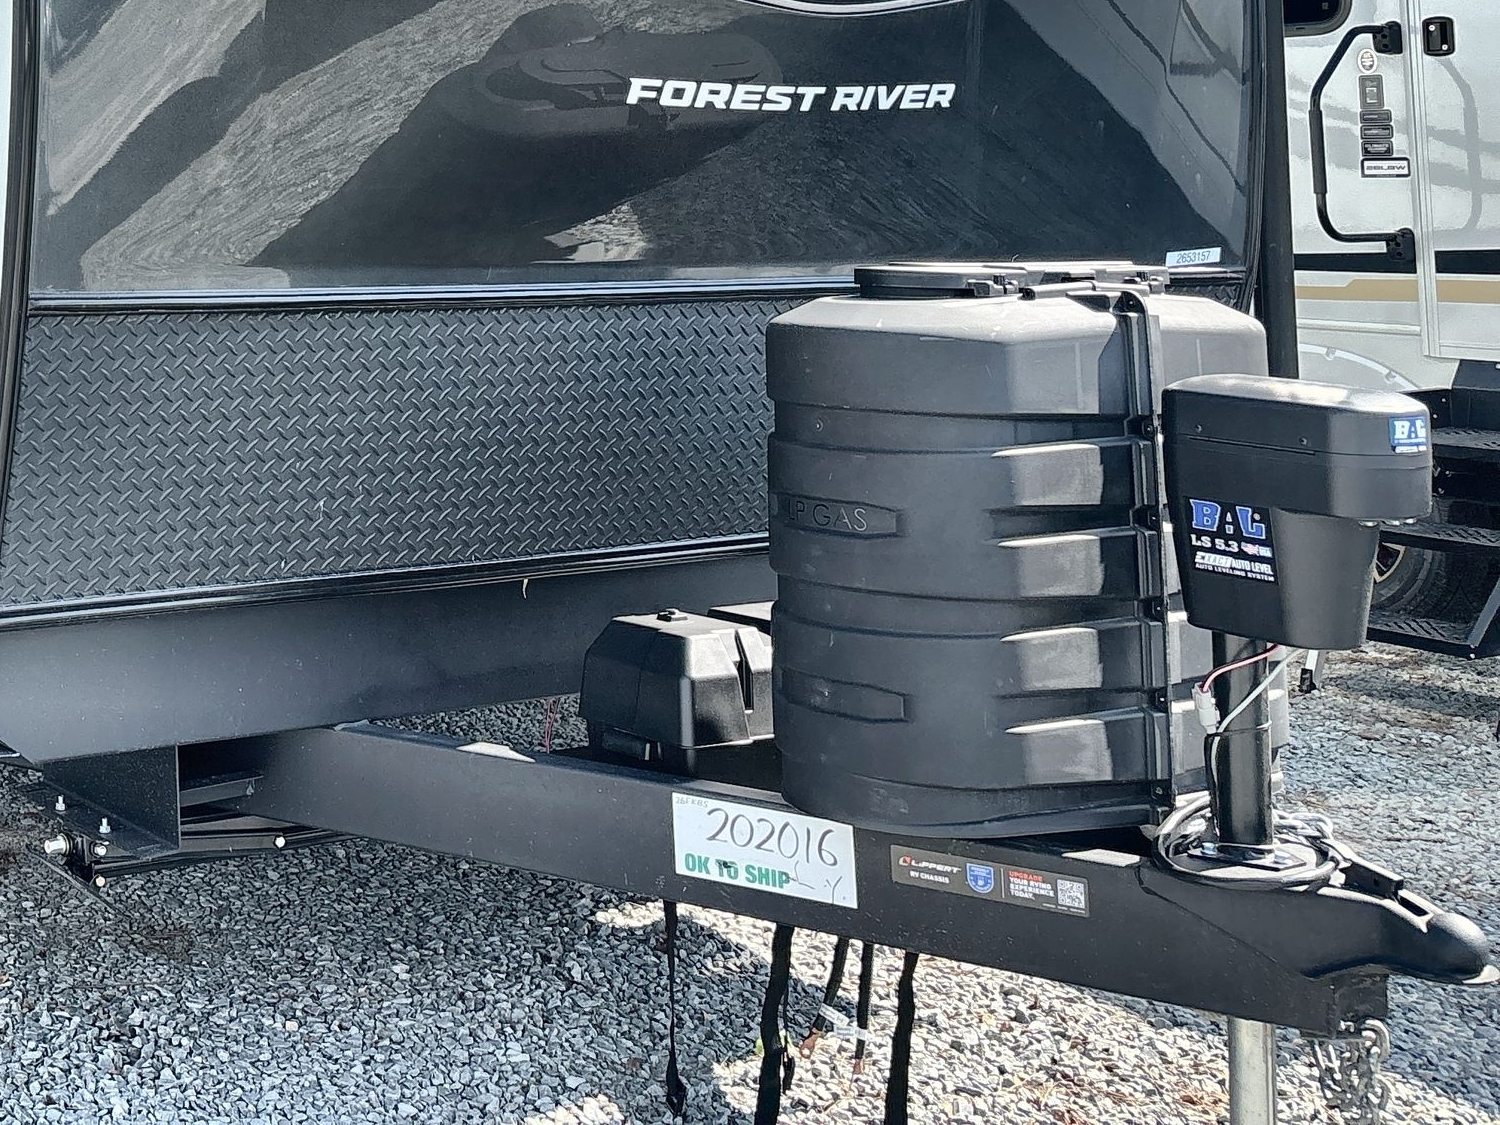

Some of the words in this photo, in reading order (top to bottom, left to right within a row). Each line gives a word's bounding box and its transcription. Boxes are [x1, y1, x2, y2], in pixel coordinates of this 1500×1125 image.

[625, 77, 827, 112] FOREST
[830, 82, 956, 111] RIVER
[1176, 250, 1211, 264] 2653157
[813, 503, 868, 532] GAS
[1189, 498, 1266, 540] BAL
[1190, 533, 1212, 548] LS
[1214, 538, 1239, 553] 5.3
[1214, 566, 1246, 577] LEVELING
[1247, 572, 1275, 581] SYSTEM
[1232, 558, 1251, 571] AUTO
[1251, 561, 1274, 575] LEVEL
[706, 807, 839, 867] 202016
[684, 852, 710, 875] OK
[714, 858, 739, 881] TO
[744, 863, 791, 889] SHIP
[911, 859, 962, 874] LIPPERT
[920, 872, 950, 884] CHASSIS
[1008, 870, 1043, 882] UPGRADE
[1009, 876, 1028, 885] YOUR
[1029, 880, 1051, 889] RVING
